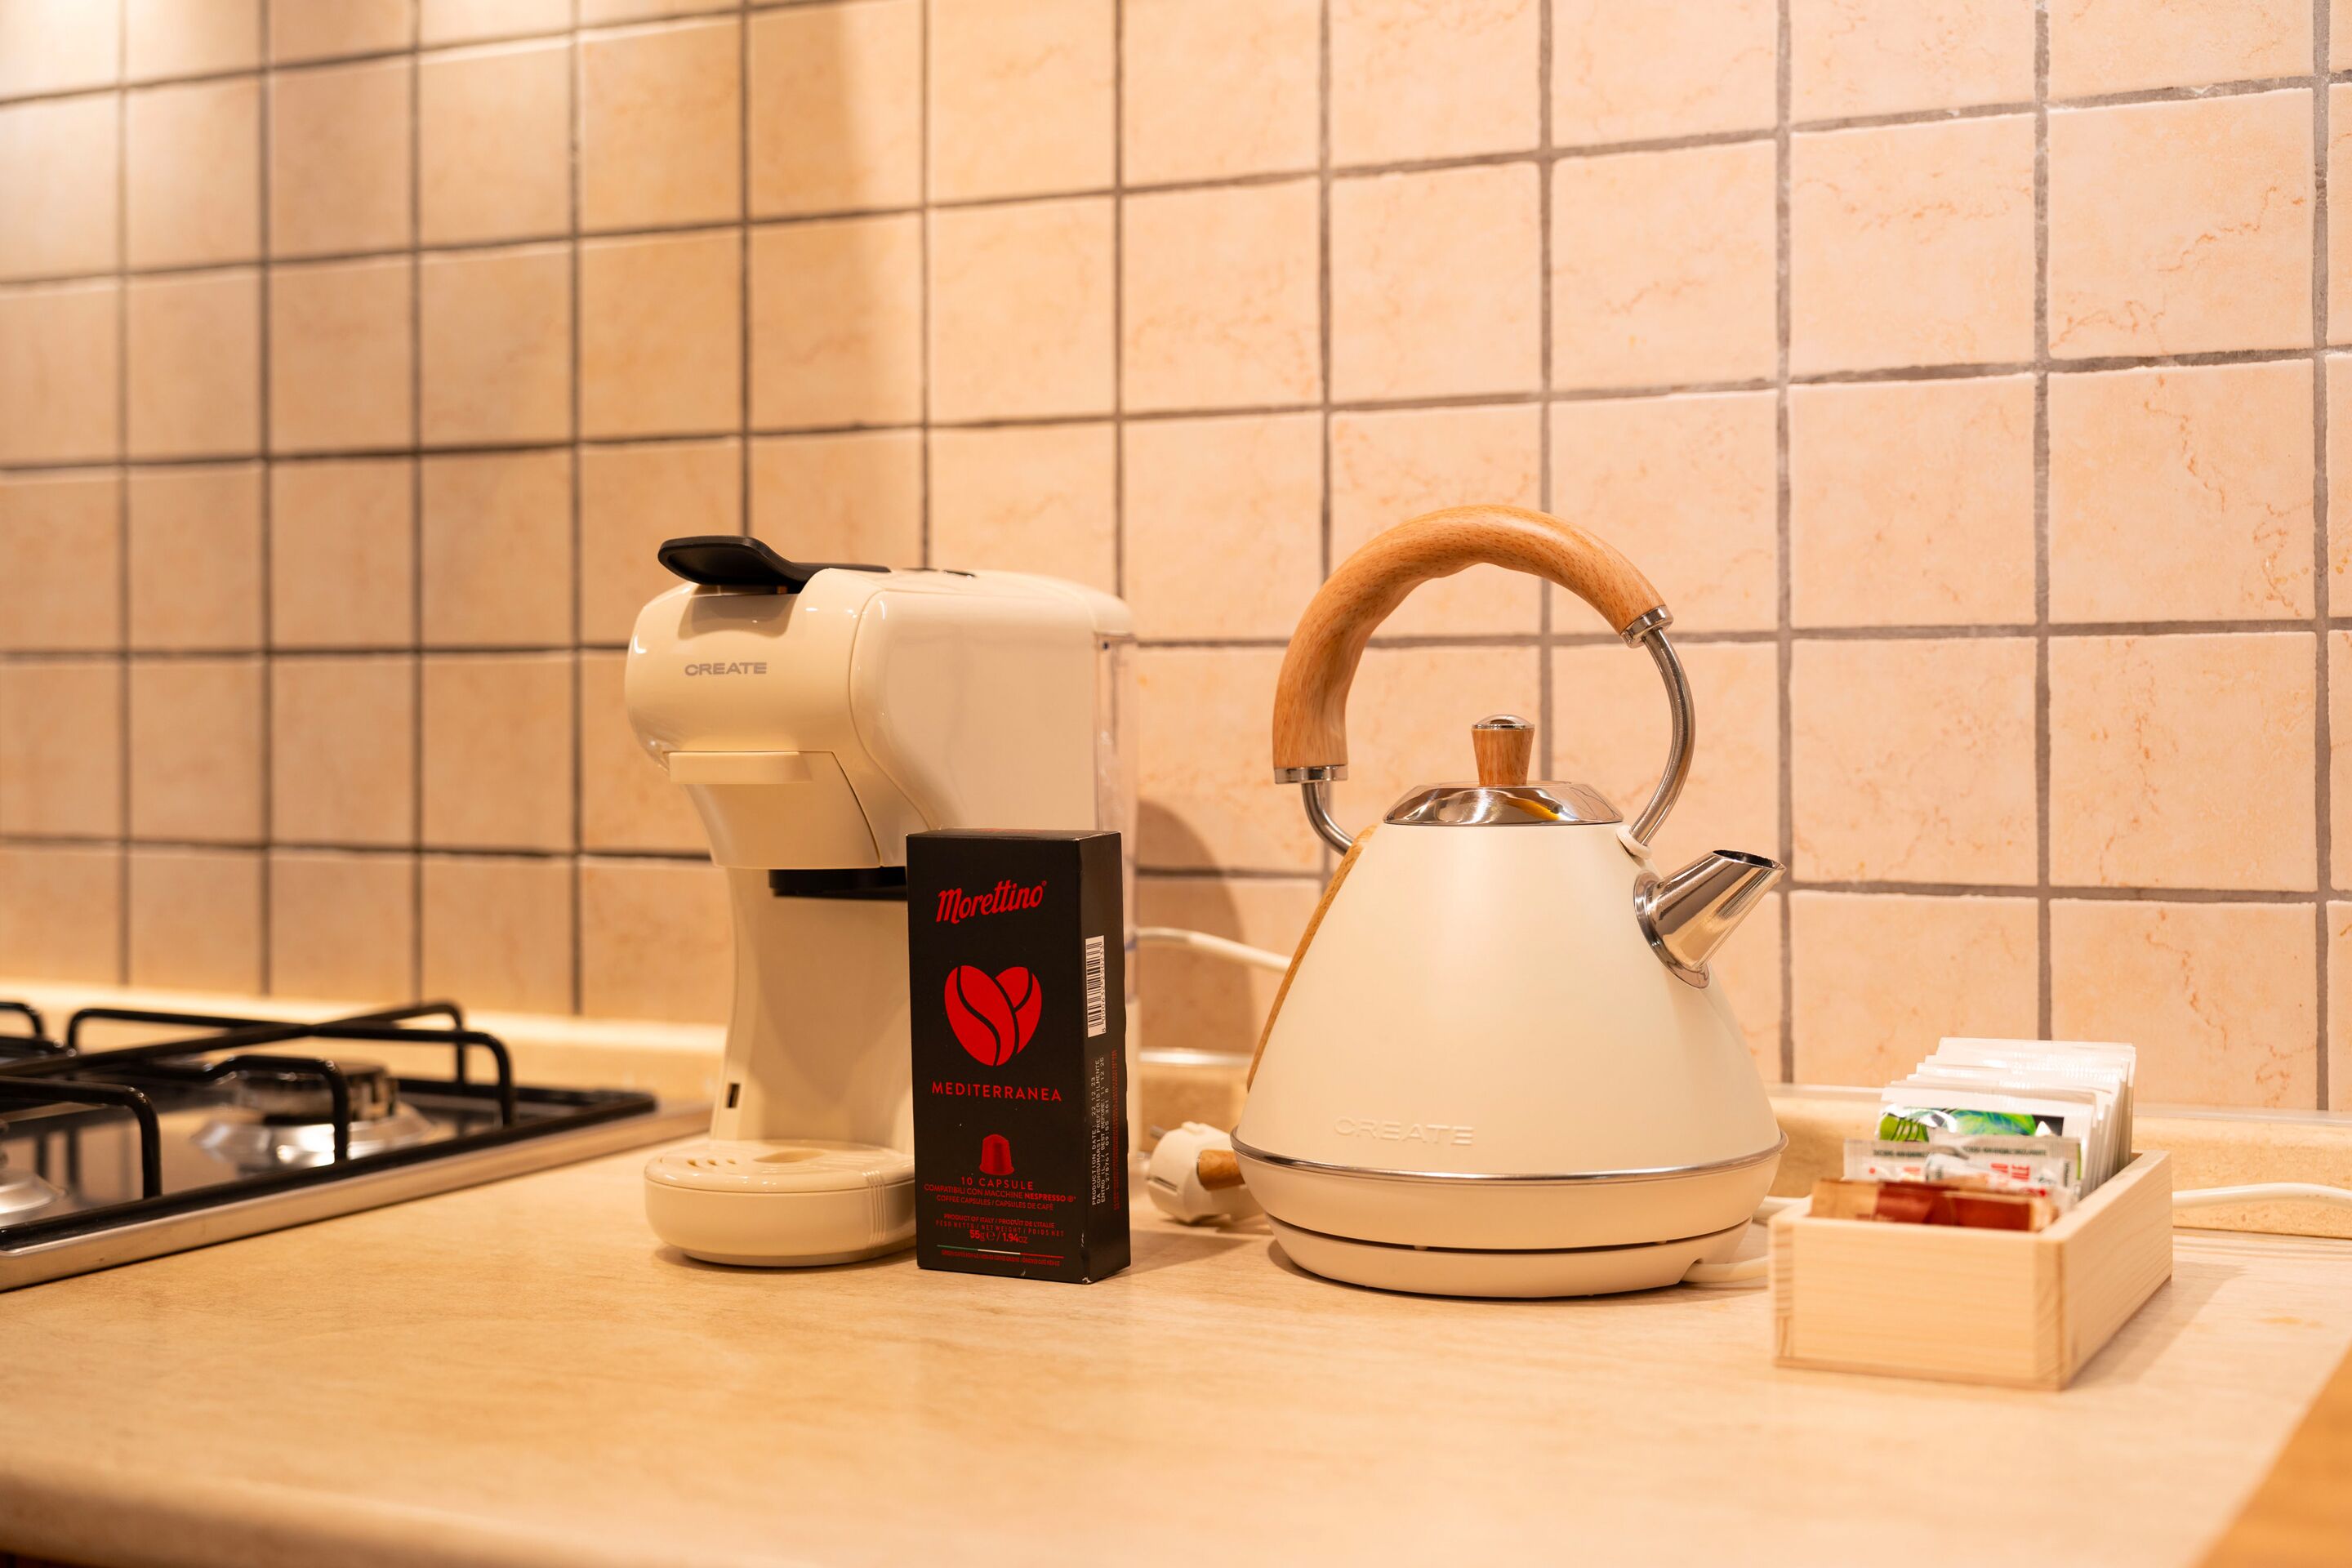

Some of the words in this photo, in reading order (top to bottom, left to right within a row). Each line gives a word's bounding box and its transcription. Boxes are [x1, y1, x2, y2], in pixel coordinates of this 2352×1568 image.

[684, 662, 768, 676] CREATE
[936, 880, 1044, 924] Morettino
[1090, 1076, 1096, 1087] 23
[1099, 1071, 1105, 1081] 12
[932, 1081, 1062, 1102] MEDITERRANEA
[1091, 1091, 1096, 1102] 12
[1100, 1086, 1105, 1095] 11
[1091, 1106, 1096, 1116] 22
[1334, 1116, 1474, 1146] CREATE
[961, 1176, 973, 1186] 10
[979, 1178, 1033, 1191] CAPSULE
[924, 1183, 966, 1195] COMPATIBILI
[967, 1187, 983, 1196] CON
[984, 1189, 1022, 1200] MACCHINE
[1024, 1192, 1066, 1202] NESPRESSO
[1096, 1192, 1101, 1205] DA
[936, 1195, 960, 1203] COFFEE
[960, 1196, 991, 1206] CAPSULES
[995, 1199, 1027, 1209] CAPSULES
[943, 1214, 970, 1222] PRODUCT
